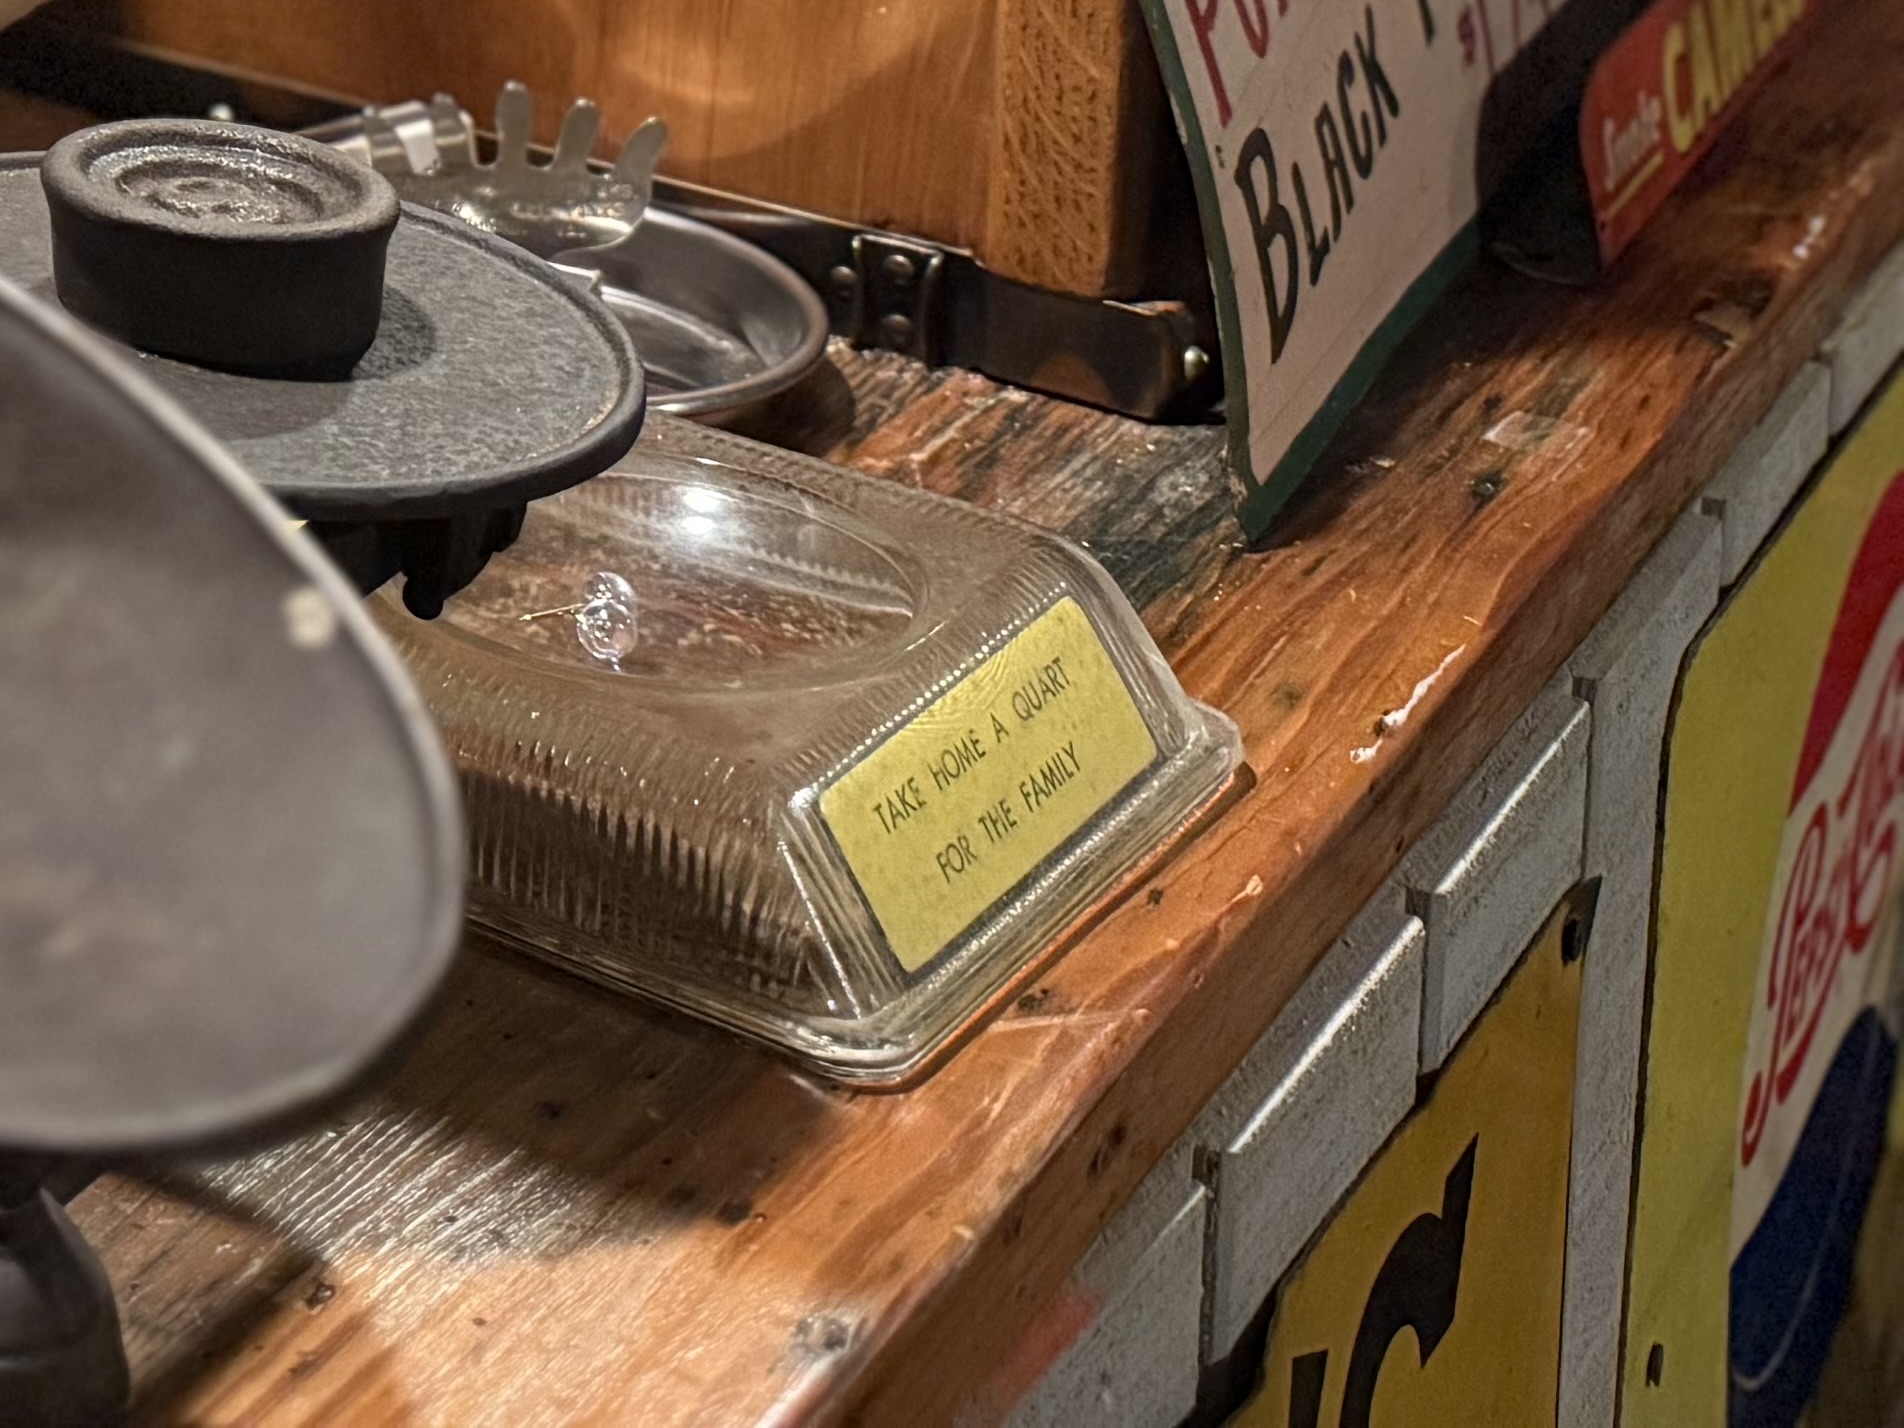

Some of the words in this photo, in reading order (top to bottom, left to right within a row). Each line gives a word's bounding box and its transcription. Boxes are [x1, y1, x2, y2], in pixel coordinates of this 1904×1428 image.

[1234, 2, 1400, 365] BLACK
[873, 776, 927, 834] TAKE
[928, 728, 987, 791] HOME
[990, 711, 1010, 743] A
[1012, 656, 1072, 721] QUART
[935, 834, 979, 885] FOR
[978, 797, 1018, 844] THE
[1018, 740, 1082, 813] FAMILY
